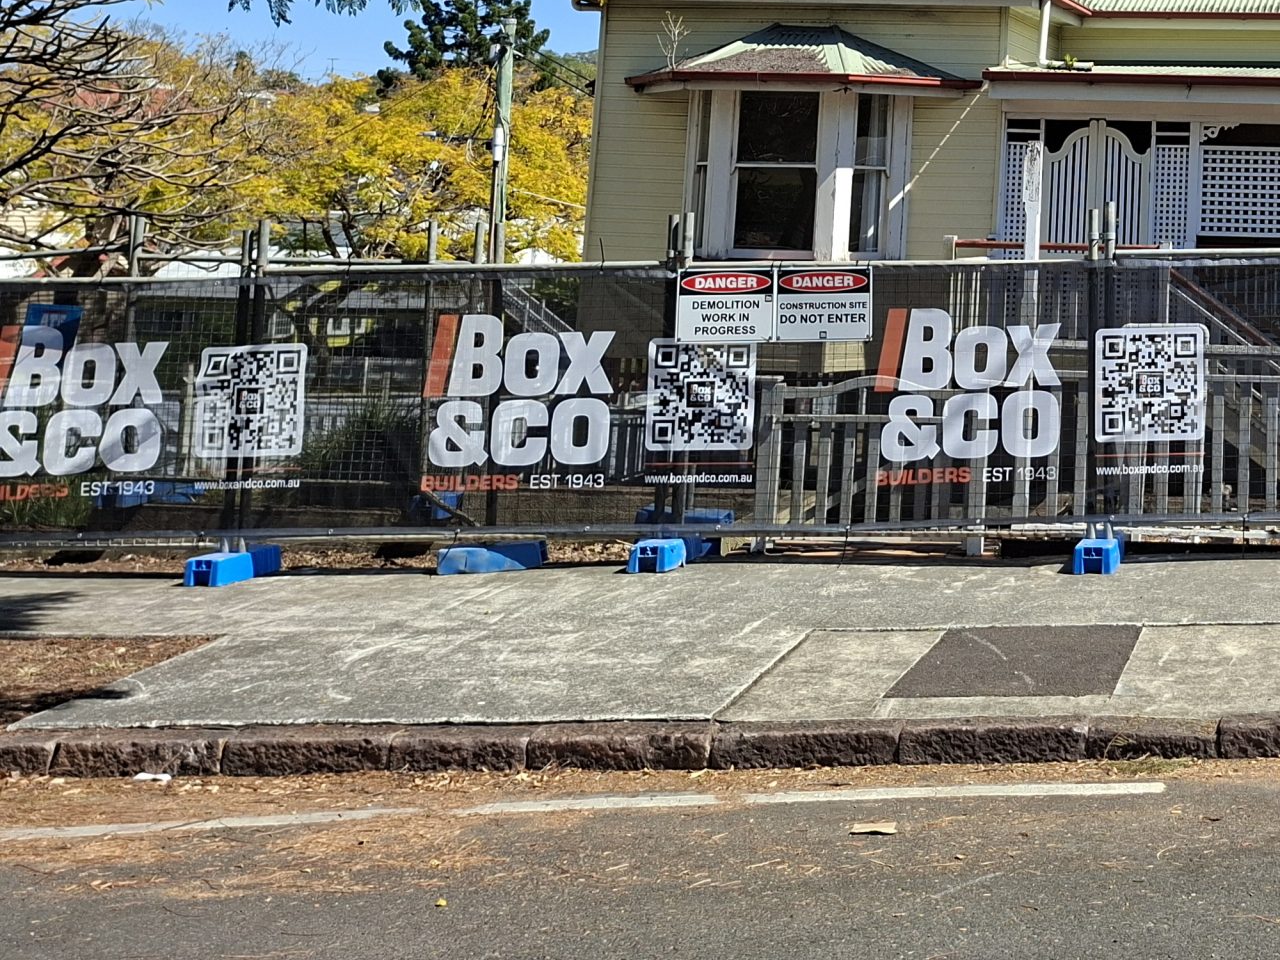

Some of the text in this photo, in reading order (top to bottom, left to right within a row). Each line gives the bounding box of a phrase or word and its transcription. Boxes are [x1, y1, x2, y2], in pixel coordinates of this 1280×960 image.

[694, 276, 758, 289] DANGER
[792, 275, 854, 288] DANGER
[692, 300, 760, 310] DEMOLITION
[779, 301, 868, 310] CONSTRUCTION SITE
[701, 313, 750, 323] WORK IN
[780, 313, 867, 324] DO NOT ENTER
[694, 325, 756, 335] PROGRESS
[428, 397, 610, 467] &CO
[881, 390, 1061, 462] &CO
[1096, 463, 1204, 475] www.boxandco.com.au
[420, 473, 604, 491] BUILDERS EST 1943
[644, 472, 753, 484] www.boxandco.com.au
[876, 466, 1058, 486] BUILDERS EST 1943
[194, 478, 300, 490] www.boxandco.com.au
[0, 480, 155, 501] ILDERS EST 1943
